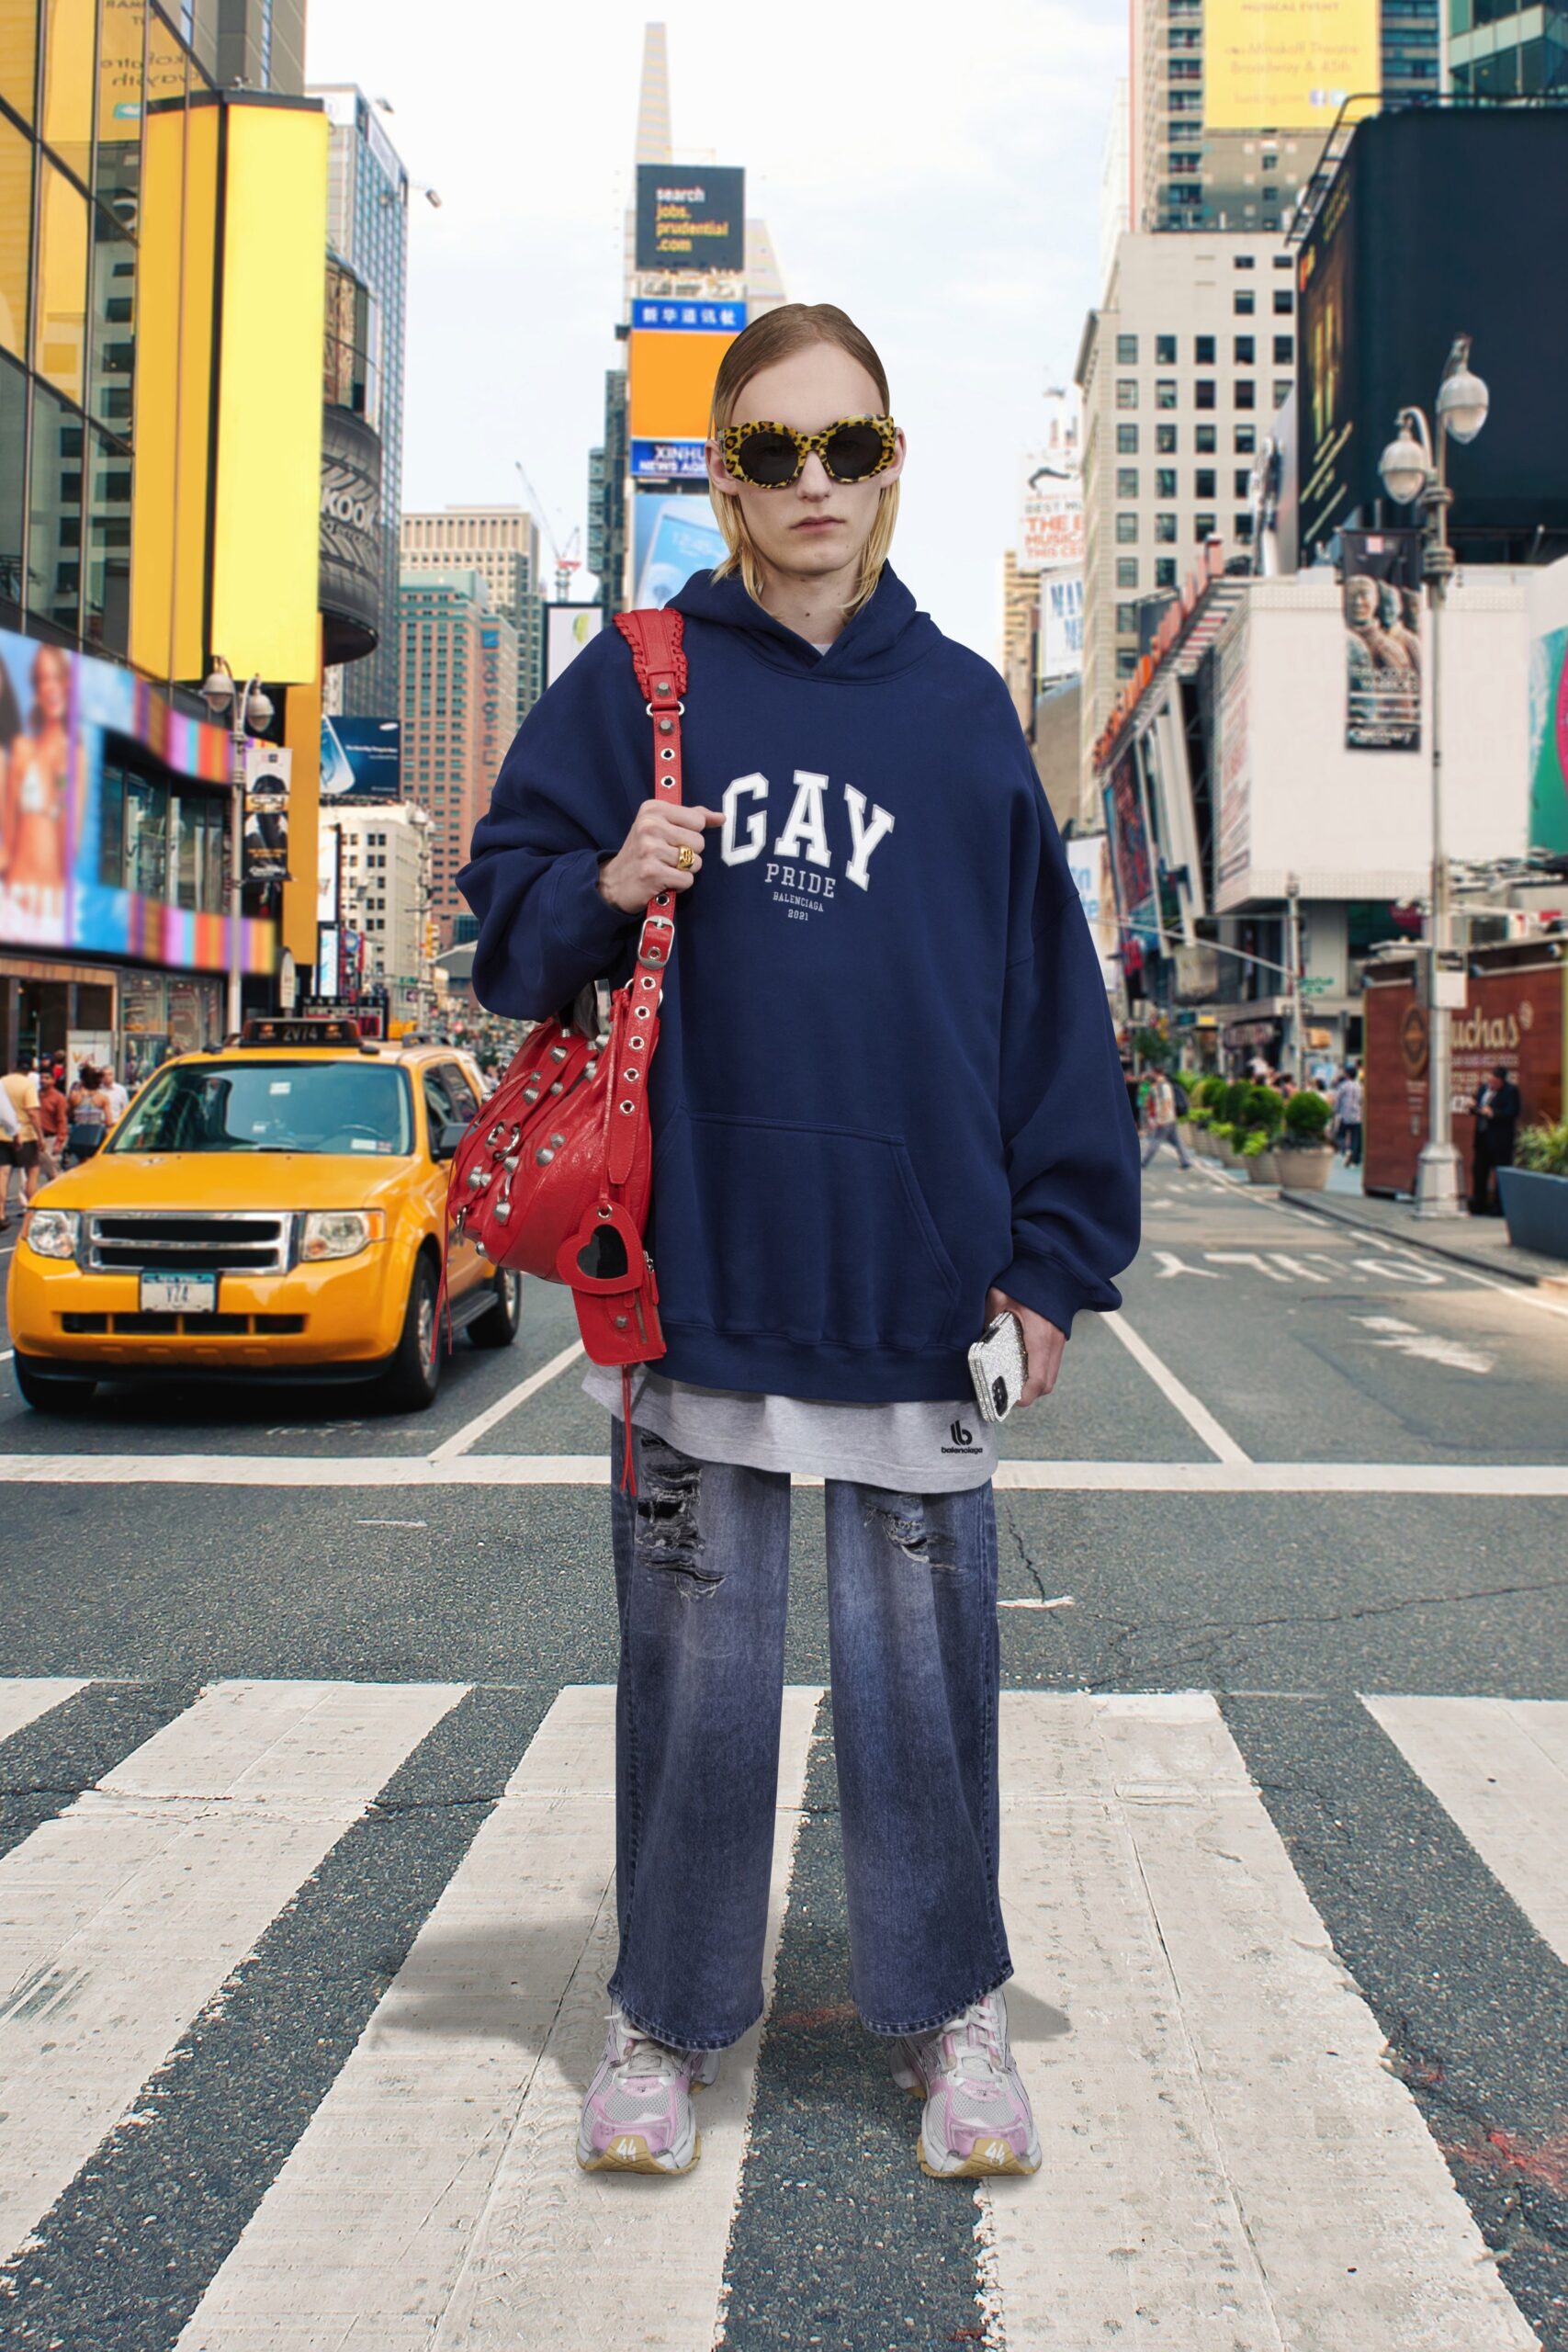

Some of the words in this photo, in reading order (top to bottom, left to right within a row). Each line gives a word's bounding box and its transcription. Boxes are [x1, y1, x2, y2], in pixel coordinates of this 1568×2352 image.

[1301, 2, 1339, 12] EVENT
[1232, 62, 1299, 74] Broadway
[656, 187, 705, 203] search
[655, 204, 691, 220] jobs.
[656, 221, 729, 238] prudential
[656, 239, 693, 253] .com
[639, 460, 678, 471] NEWS
[1025, 500, 1061, 514] BEST
[1026, 514, 1068, 532] THE
[1027, 546, 1058, 560] THIS
[721, 770, 895, 891] GAY
[764, 863, 836, 899] PRIDE
[773, 891, 824, 912] BALENCIAGA
[787, 909, 809, 922] 2021
[283, 1023, 319, 1042] 2V74
[941, 1446, 983, 1455] balenciaga
[616, 2138, 637, 2162] 44
[985, 2142, 1006, 2166] 44
